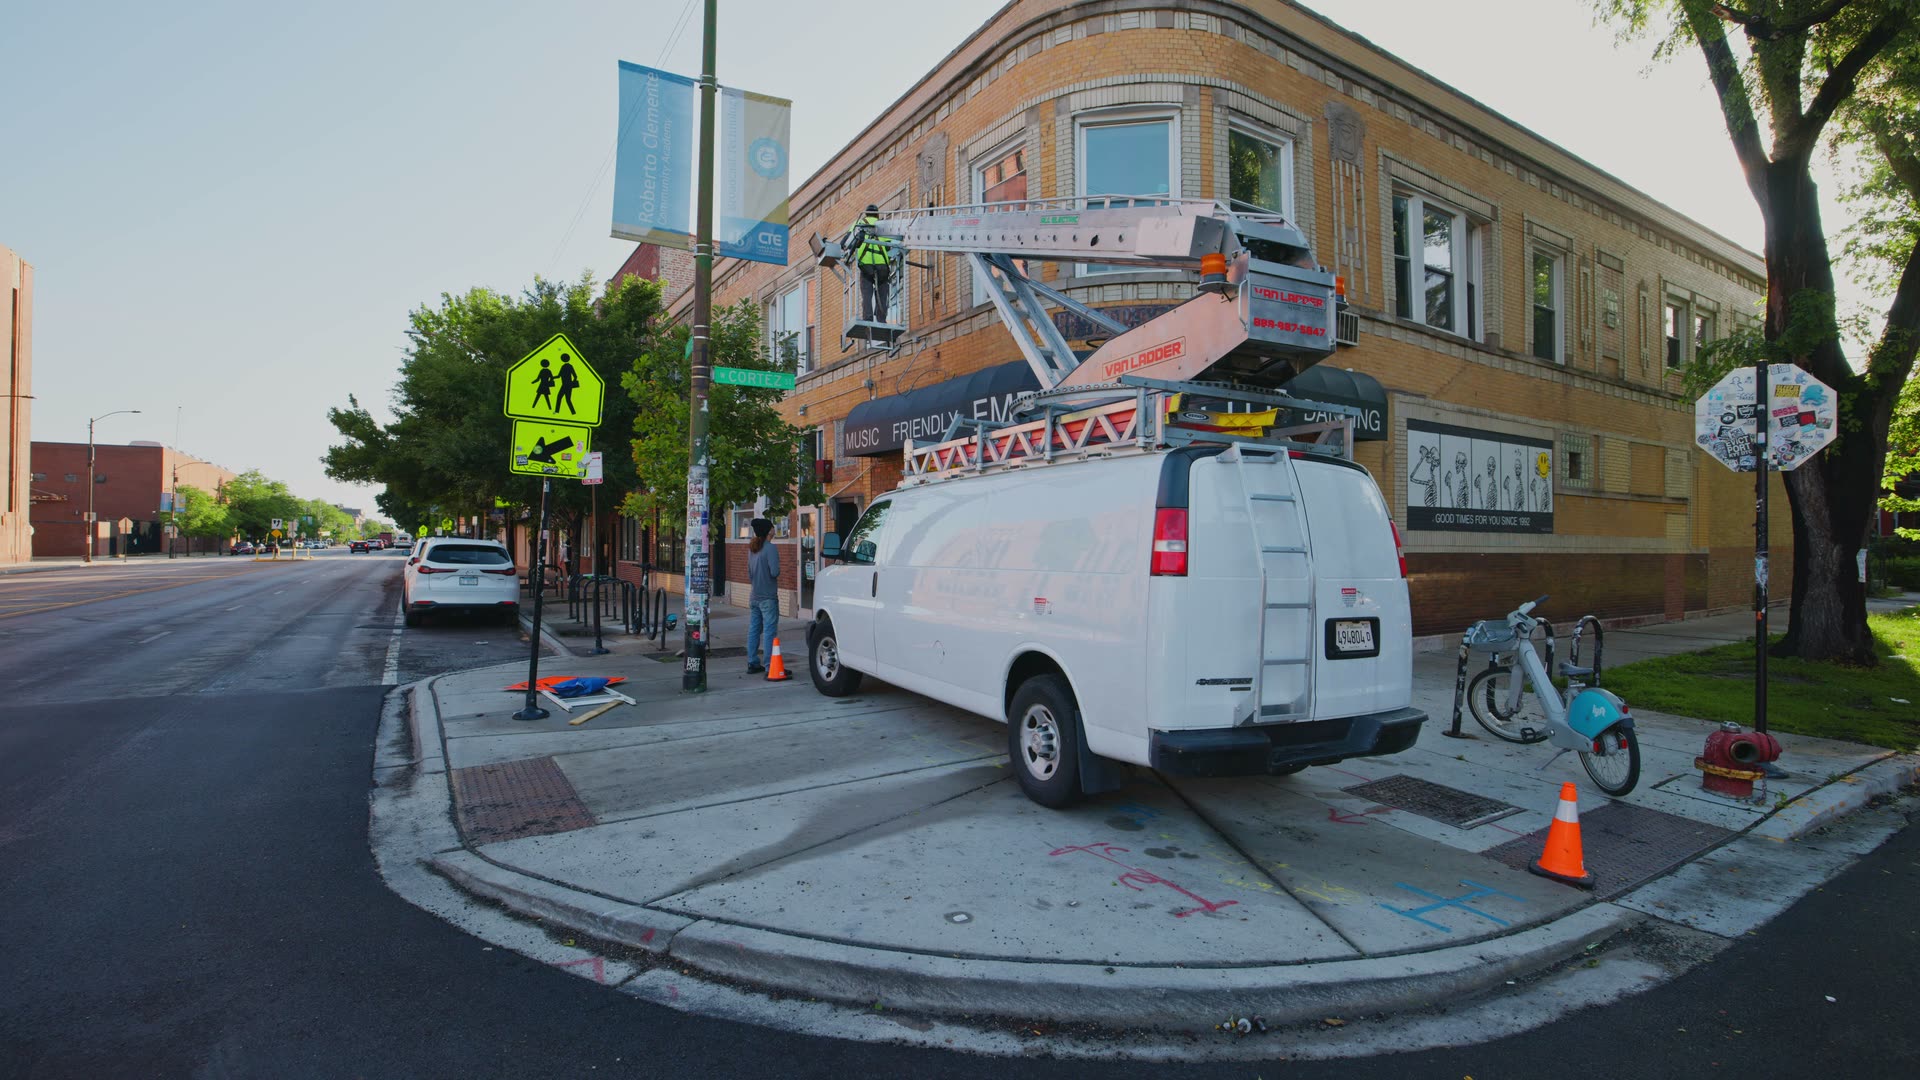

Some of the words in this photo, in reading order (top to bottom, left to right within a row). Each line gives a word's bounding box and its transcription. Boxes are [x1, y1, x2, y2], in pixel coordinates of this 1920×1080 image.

[642, 71, 659, 149] Clemente
[663, 113, 673, 162] Academy
[638, 153, 657, 224] Roberto
[657, 163, 671, 225] Community
[758, 231, 783, 247] CTE
[1254, 286, 1279, 300] VAN
[1105, 359, 1129, 377] VAN
[1130, 341, 1182, 369] LADDER
[728, 370, 782, 387] CORTEZ
[845, 427, 880, 451] MUSIC
[892, 409, 960, 443] FRIENDLY
[1726, 435, 1750, 447] EVICT
[1727, 442, 1751, 456] PORT
[1435, 513, 1455, 523] GOOD
[1455, 514, 1474, 524] TIMES
[1474, 515, 1487, 525] FOR
[1488, 515, 1501, 526] YOU
[1501, 516, 1518, 526] SINCE
[1337, 629, 1365, 645] 494804
